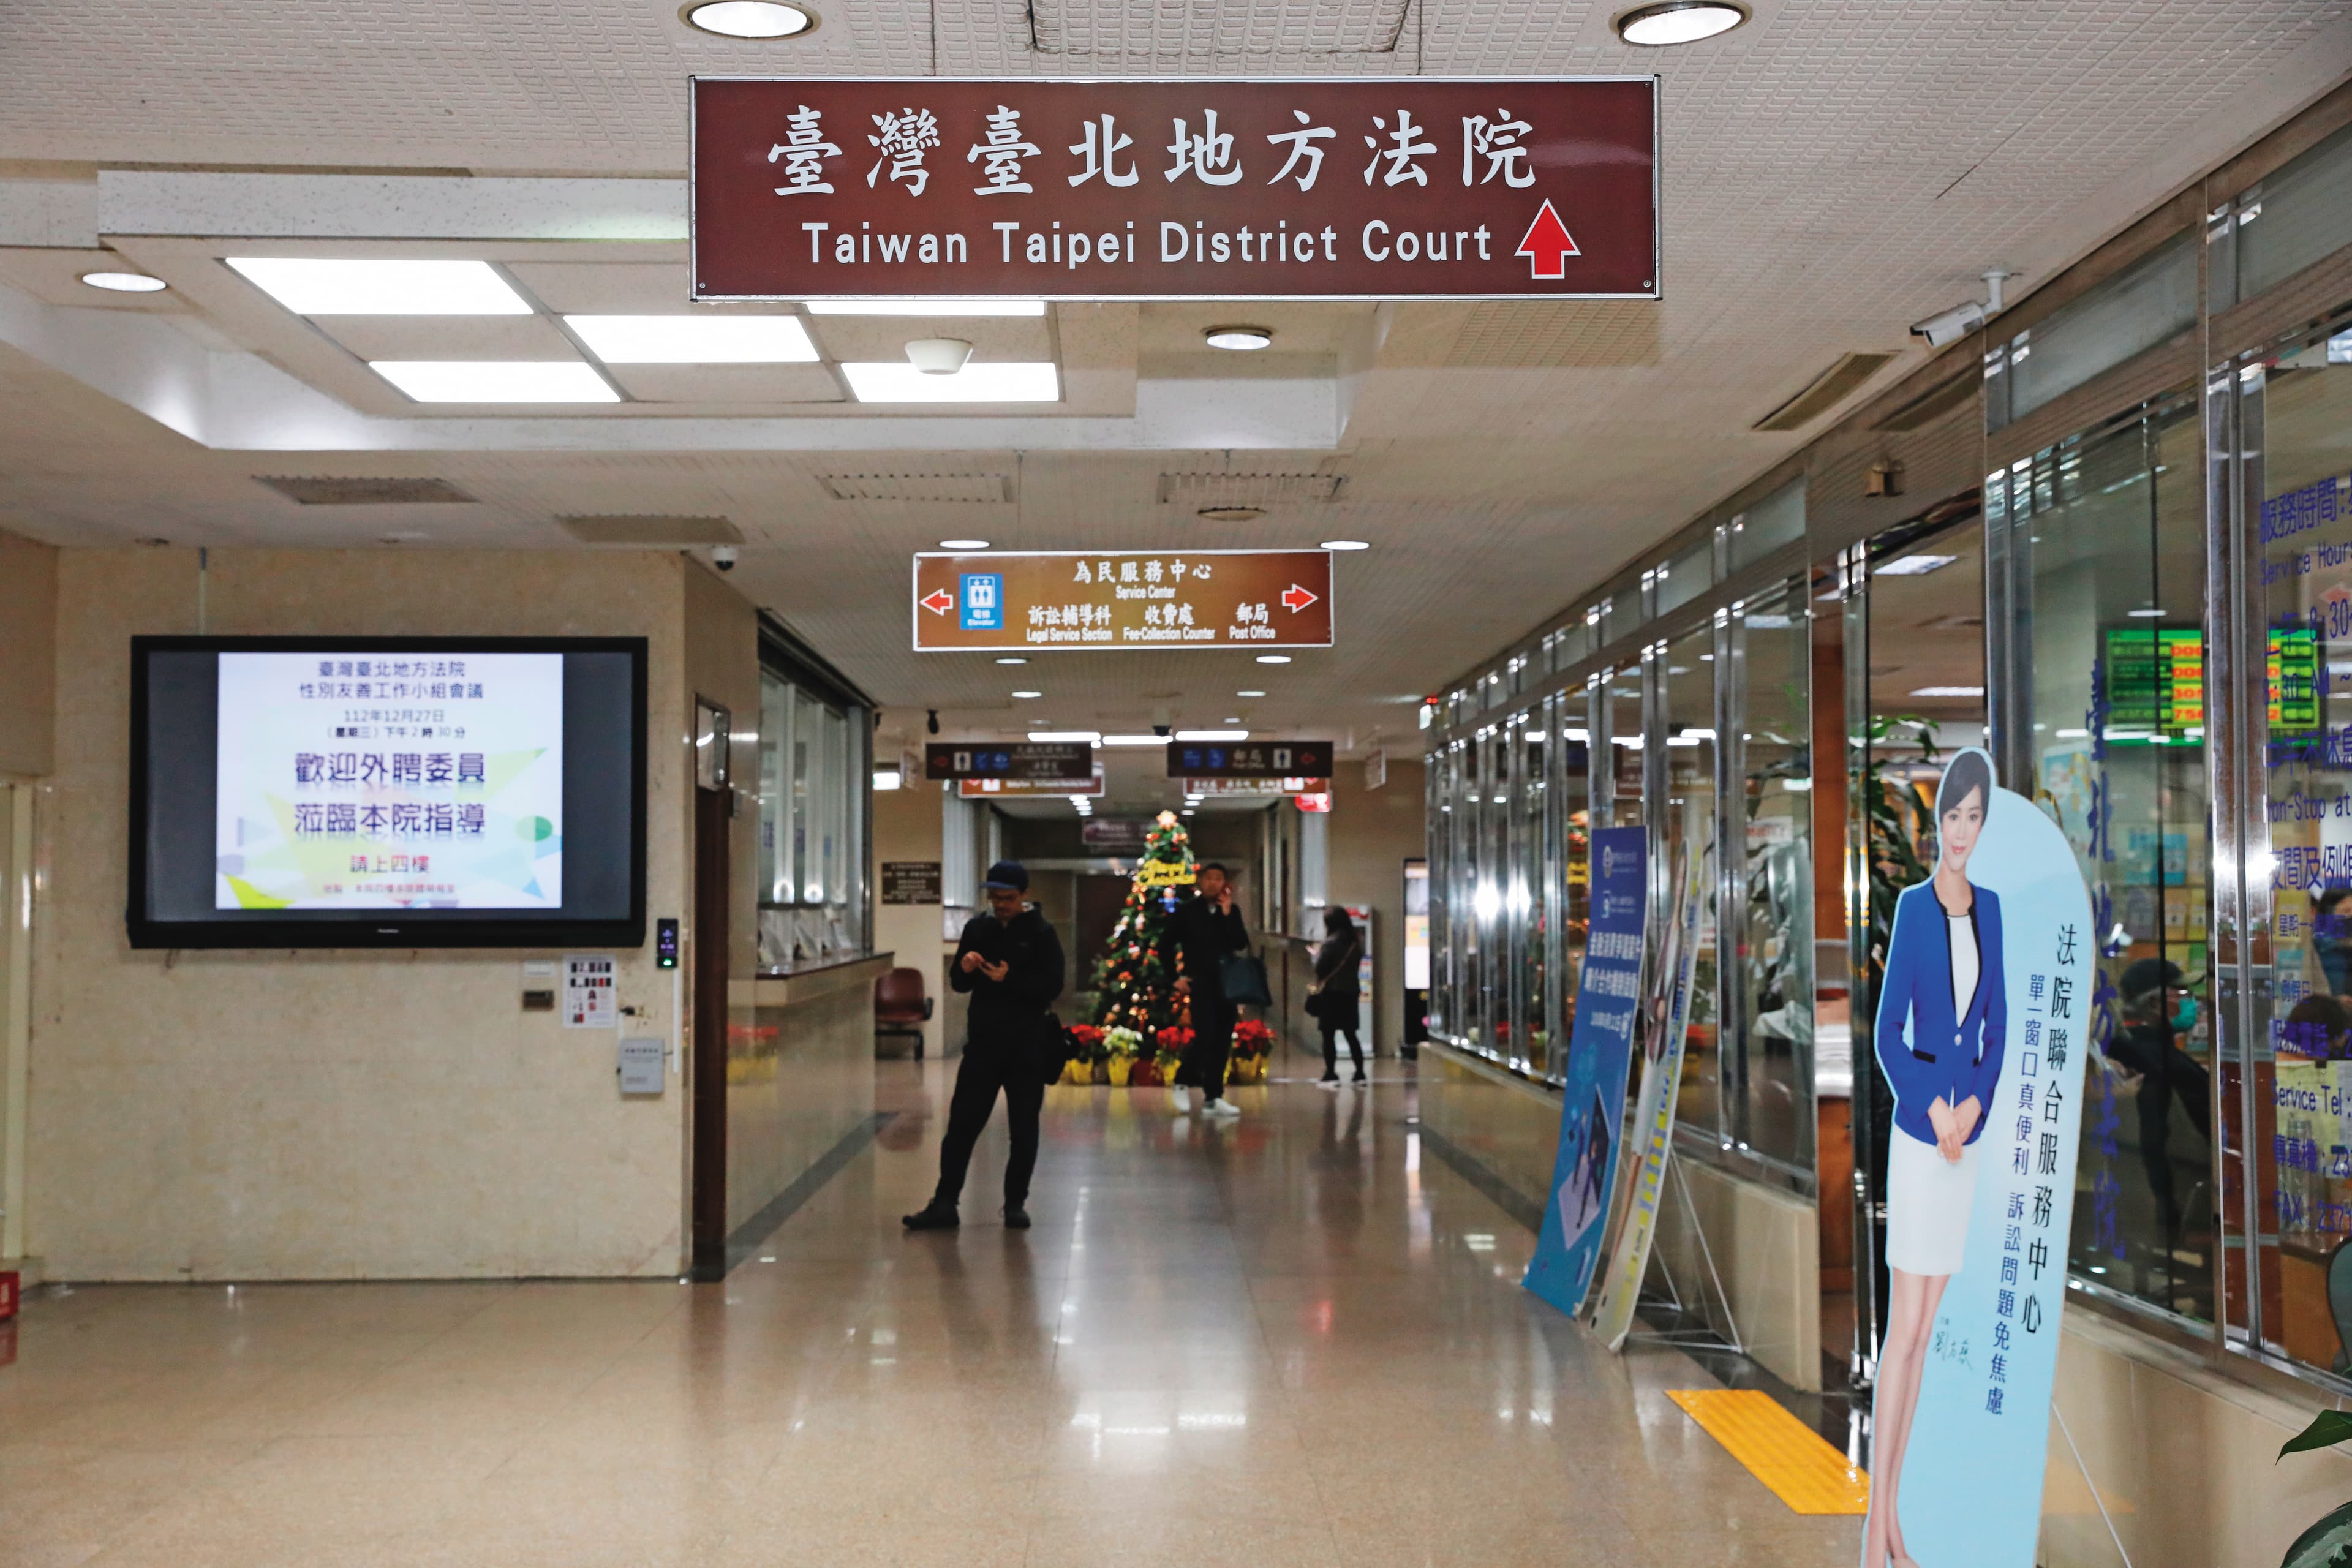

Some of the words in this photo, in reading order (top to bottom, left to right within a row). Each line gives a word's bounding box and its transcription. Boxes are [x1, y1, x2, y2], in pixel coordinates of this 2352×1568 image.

[767, 104, 1537, 197] 臺灣臺北地方法院
[801, 222, 968, 263] Taiwan
[992, 221, 1135, 271] Taipei
[1159, 219, 1338, 263] District
[1362, 219, 1492, 263] Court
[2260, 472, 2352, 544] 服務時間:
[1073, 560, 1212, 584] 為民服務中心
[1028, 604, 1112, 626] 訴訟輔導科
[1145, 604, 1194, 626] 收費處
[1236, 602, 1270, 625] 郵局
[1026, 627, 1049, 643] Legal
[1049, 627, 1080, 642] Service
[1082, 627, 1113, 642] Section
[1229, 625, 1250, 640] Post
[1251, 625, 1276, 640] Office
[318, 660, 466, 677] 臺灣臺北地方法院
[300, 682, 483, 699] 性別友善工作小組會議
[344, 709, 445, 723] 112年12月27日
[295, 752, 486, 783] 歡迎外聘委員
[2335, 791, 2351, 818] at
[294, 803, 486, 834] 蒞臨本院指導
[350, 855, 430, 873] 請上四樓
[2011, 974, 2045, 1176] 單一窗口真便利
[2271, 1077, 2316, 1113] Service
[2022, 924, 2078, 1335] 法院聯合服務中心
[1985, 1191, 2026, 1416] 訴訟問題免焦慮
